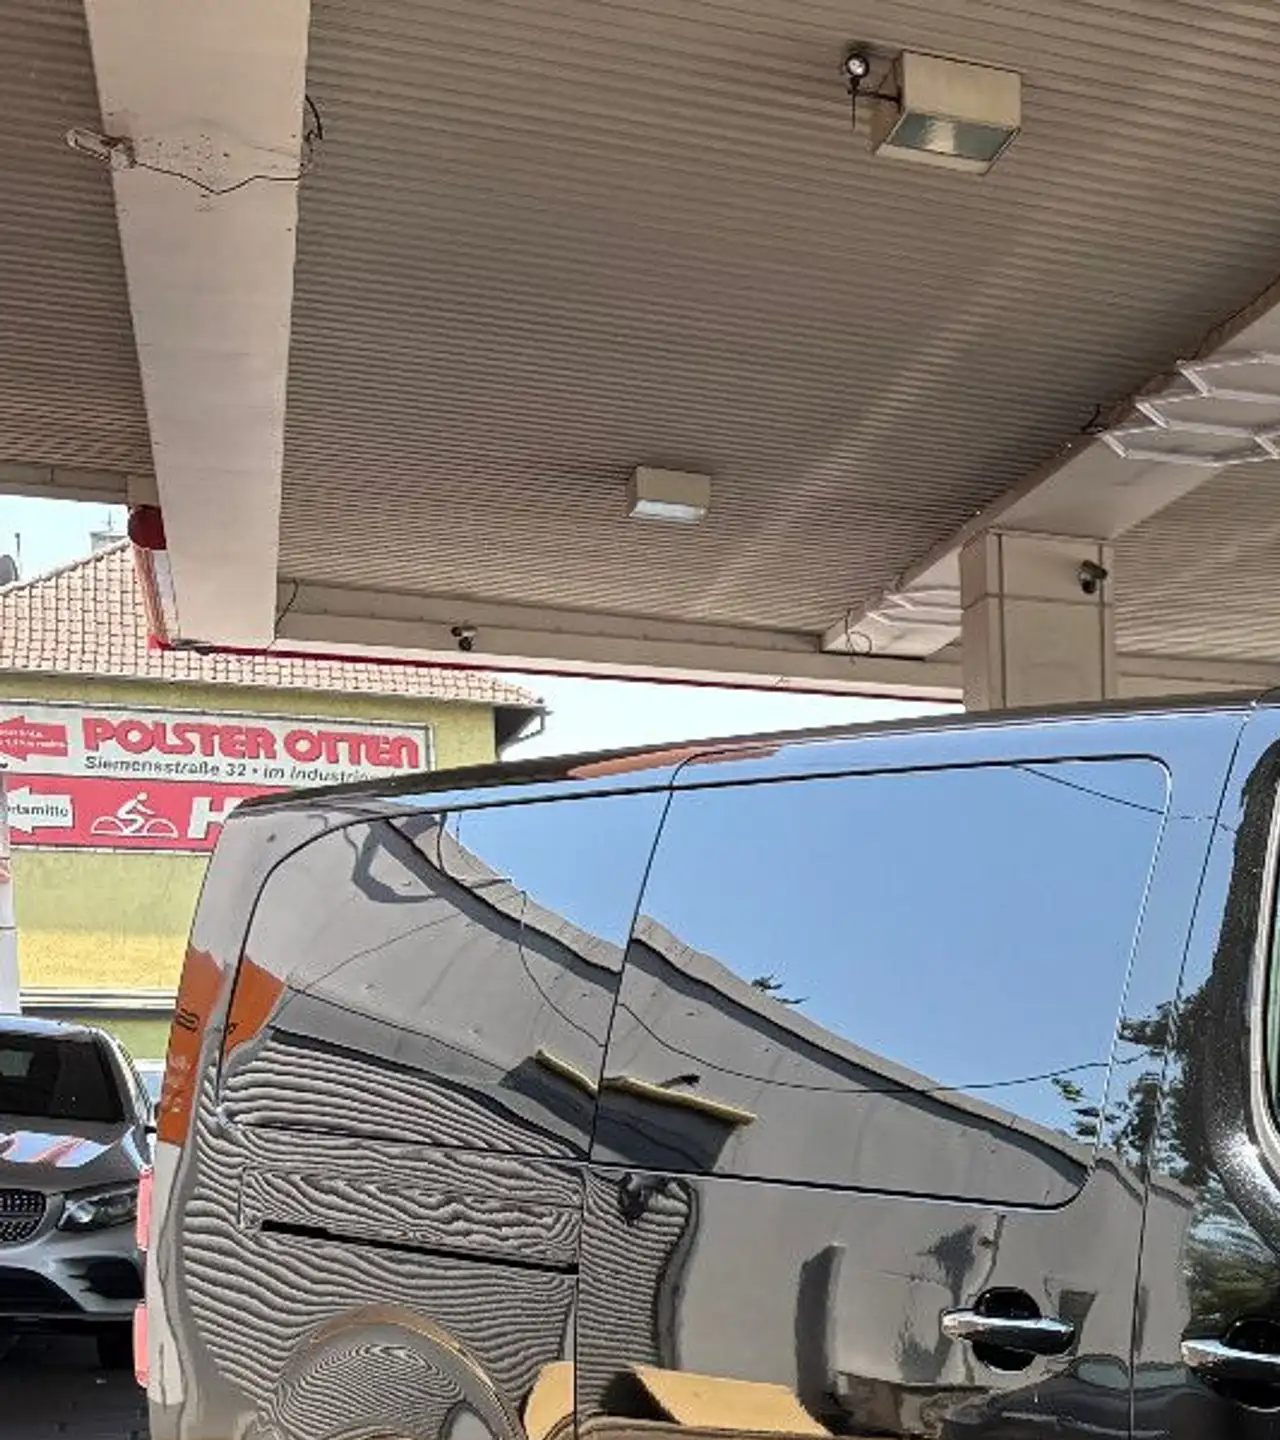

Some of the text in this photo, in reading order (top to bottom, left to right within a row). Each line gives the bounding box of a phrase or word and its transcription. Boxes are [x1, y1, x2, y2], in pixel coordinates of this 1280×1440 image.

[82, 717, 420, 769] POLSTER OTTEN
[226, 763, 247, 778] 32
